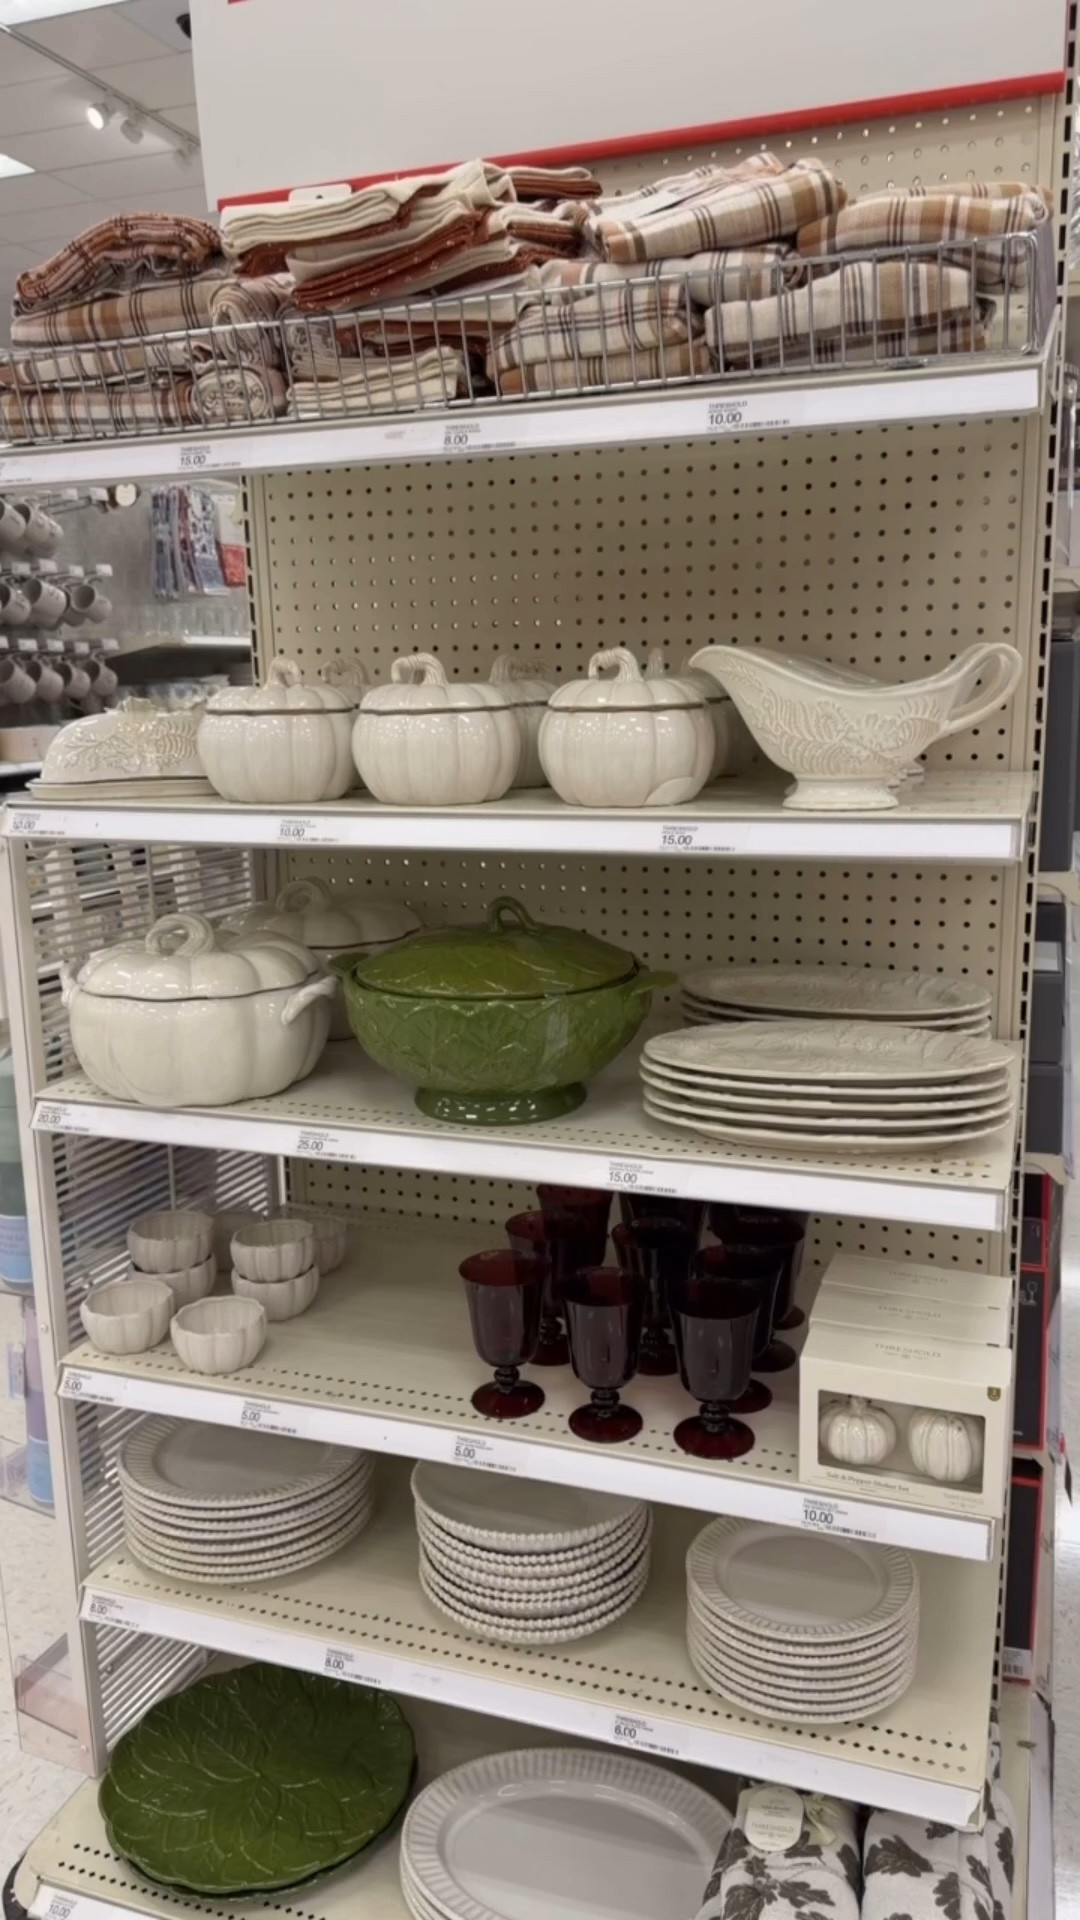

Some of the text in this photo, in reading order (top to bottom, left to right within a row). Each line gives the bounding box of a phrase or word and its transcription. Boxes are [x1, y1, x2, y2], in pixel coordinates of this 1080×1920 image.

[709, 412, 742, 425] 10.00
[443, 434, 468, 445] 8.00
[180, 455, 206, 466] 15.00
[279, 827, 305, 837] 10.00
[661, 834, 693, 846] 15.00
[37, 1113, 61, 1124] 20.00
[296, 1139, 323, 1151] 25.00
[608, 1171, 638, 1184] 15.00
[875, 1343, 941, 1358] THRESHOLD
[63, 1379, 82, 1391] 5.00
[241, 1409, 261, 1423] 5.00
[454, 1445, 476, 1459] 5.00
[803, 1509, 834, 1524] 10.00
[324, 1656, 345, 1670] 8.00
[614, 1724, 637, 1739] 6.00
[752, 1822, 794, 1833] THRESHOLD
[48, 1904, 71, 1919] 10.00
